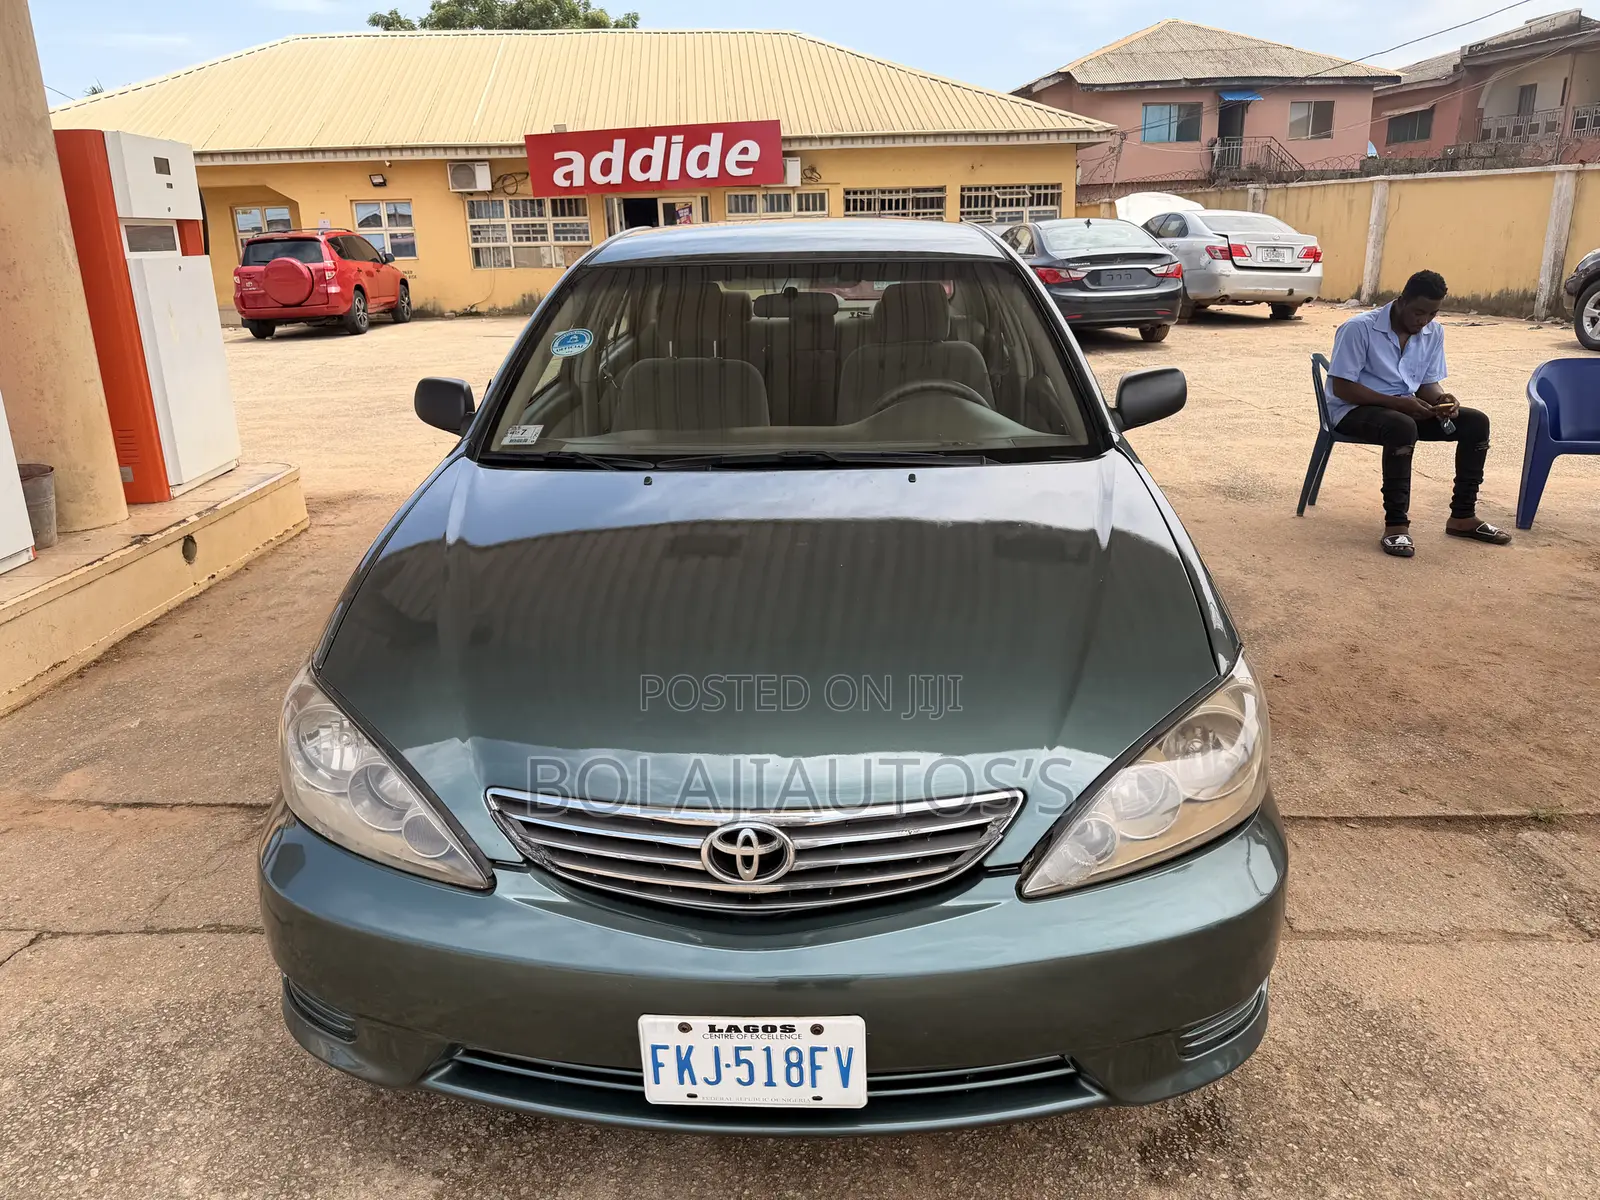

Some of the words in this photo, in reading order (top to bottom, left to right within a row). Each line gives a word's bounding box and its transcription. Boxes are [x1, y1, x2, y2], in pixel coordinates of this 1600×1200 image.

[552, 132, 761, 188] addide
[707, 1024, 797, 1034] LAGOS
[750, 1033, 803, 1041] EXCELLENCE
